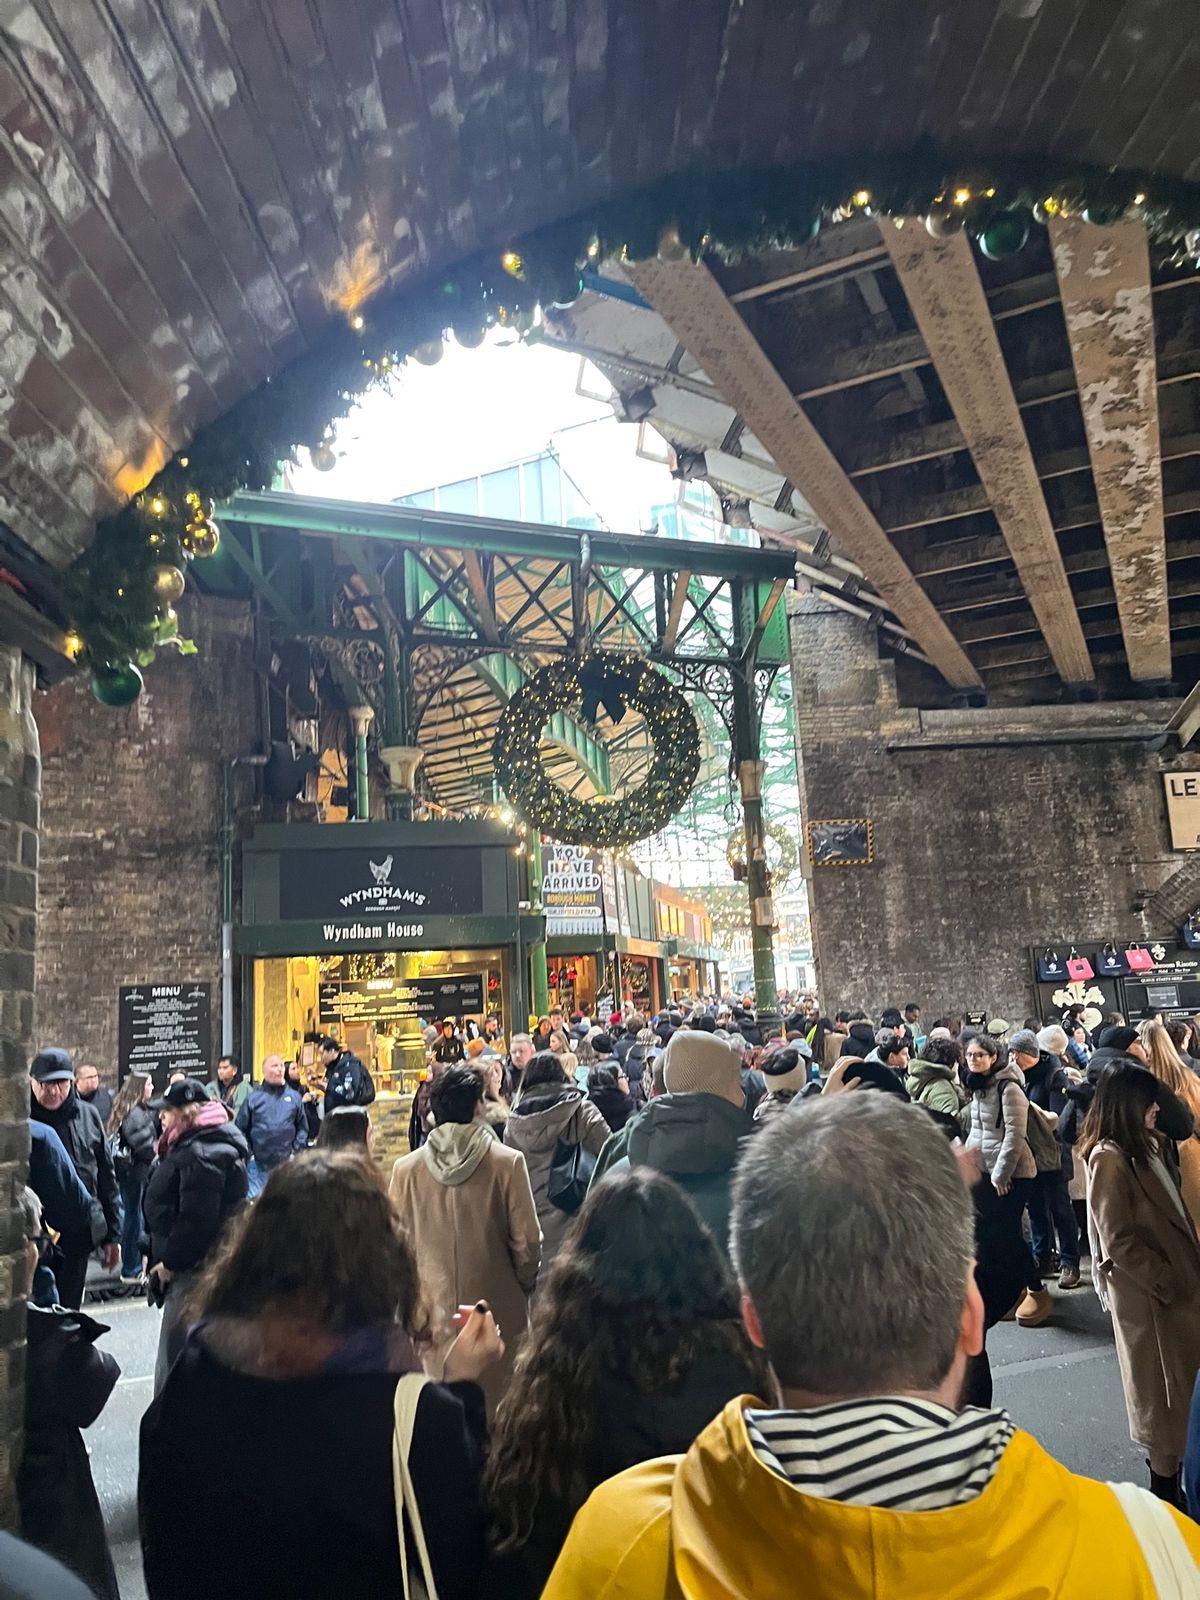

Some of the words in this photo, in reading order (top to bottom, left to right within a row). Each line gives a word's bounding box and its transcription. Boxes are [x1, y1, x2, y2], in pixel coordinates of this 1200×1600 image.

[544, 876, 600, 889] ARRIVED
[340, 886, 426, 907] WYNDHAM'S
[323, 923, 382, 942] Wyndham
[387, 922, 423, 938] House
[152, 986, 180, 997] MENU
